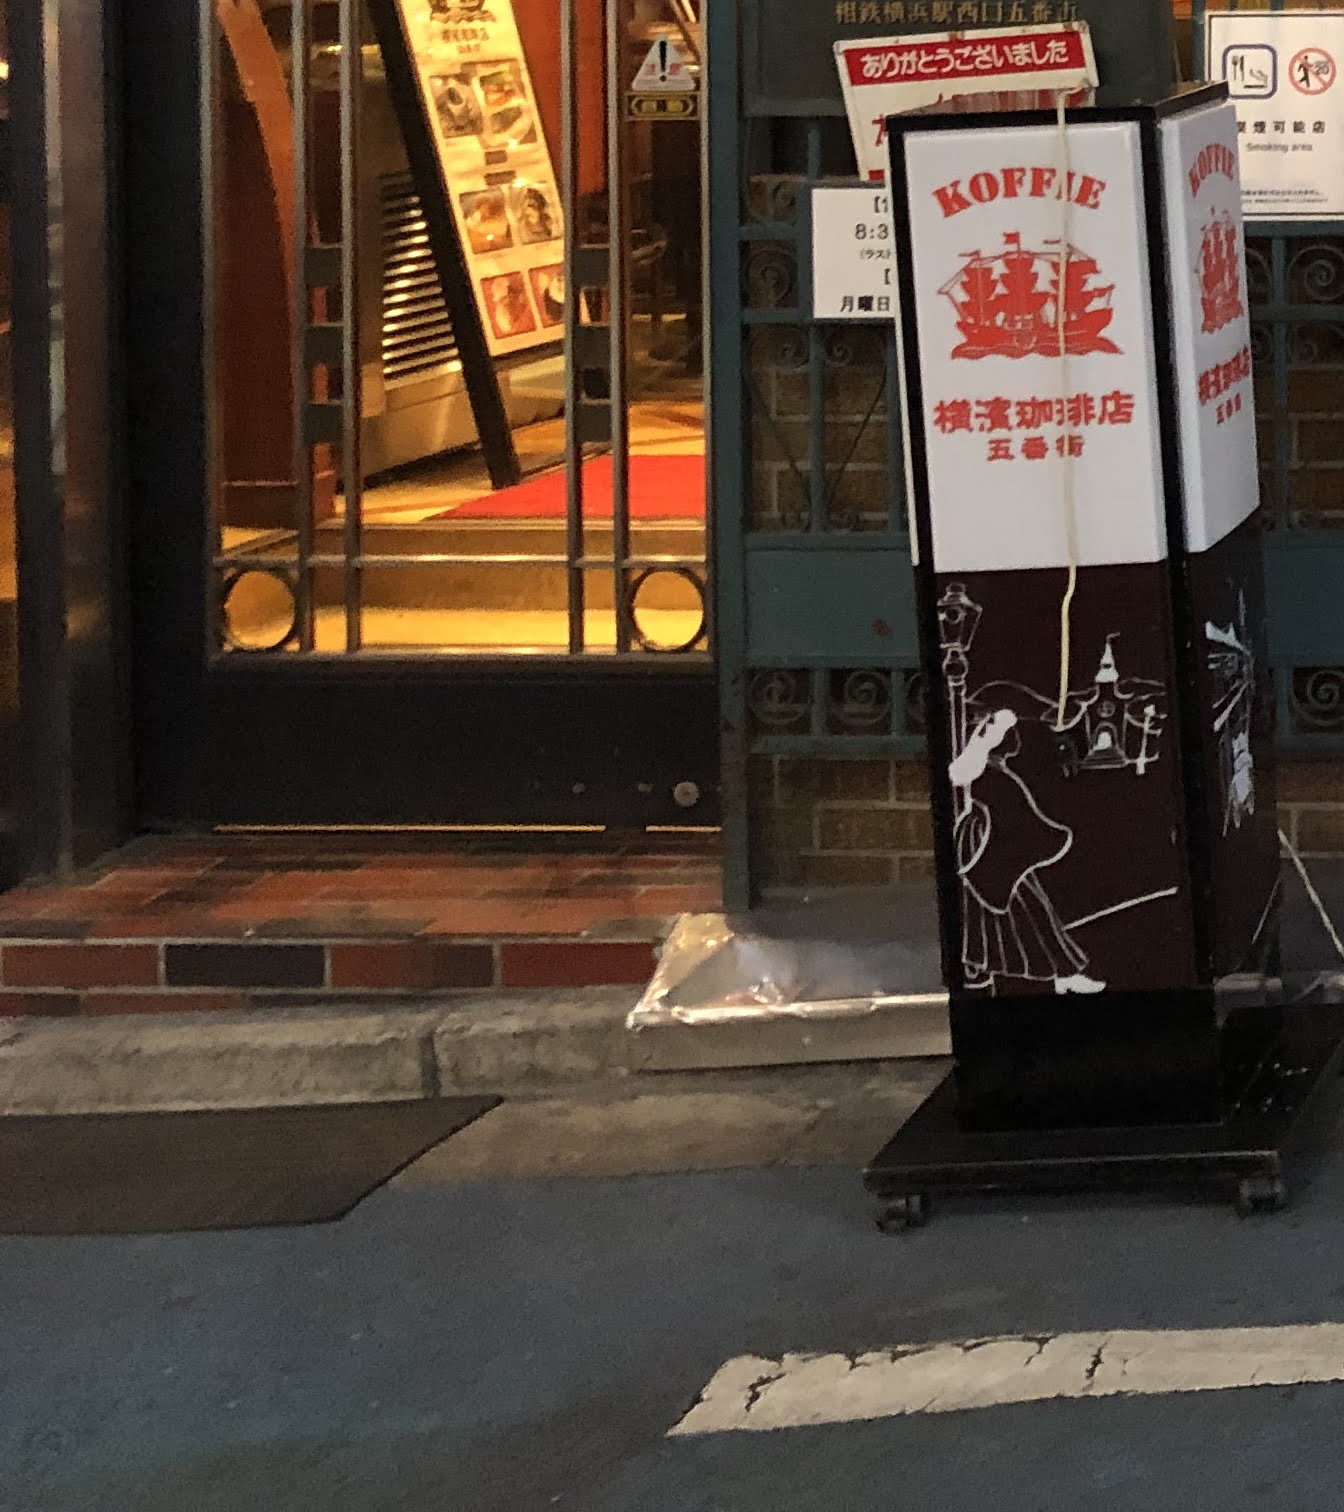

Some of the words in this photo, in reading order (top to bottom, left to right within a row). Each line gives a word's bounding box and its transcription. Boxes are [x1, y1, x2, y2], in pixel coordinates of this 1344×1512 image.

[861, 39, 1069, 78] ありがとうございました
[932, 167, 1106, 217] KOFFIE
[840, 296, 890, 313] 月曜日
[933, 390, 1136, 434] 横濱珈琲店
[987, 435, 1085, 462] 五番街
